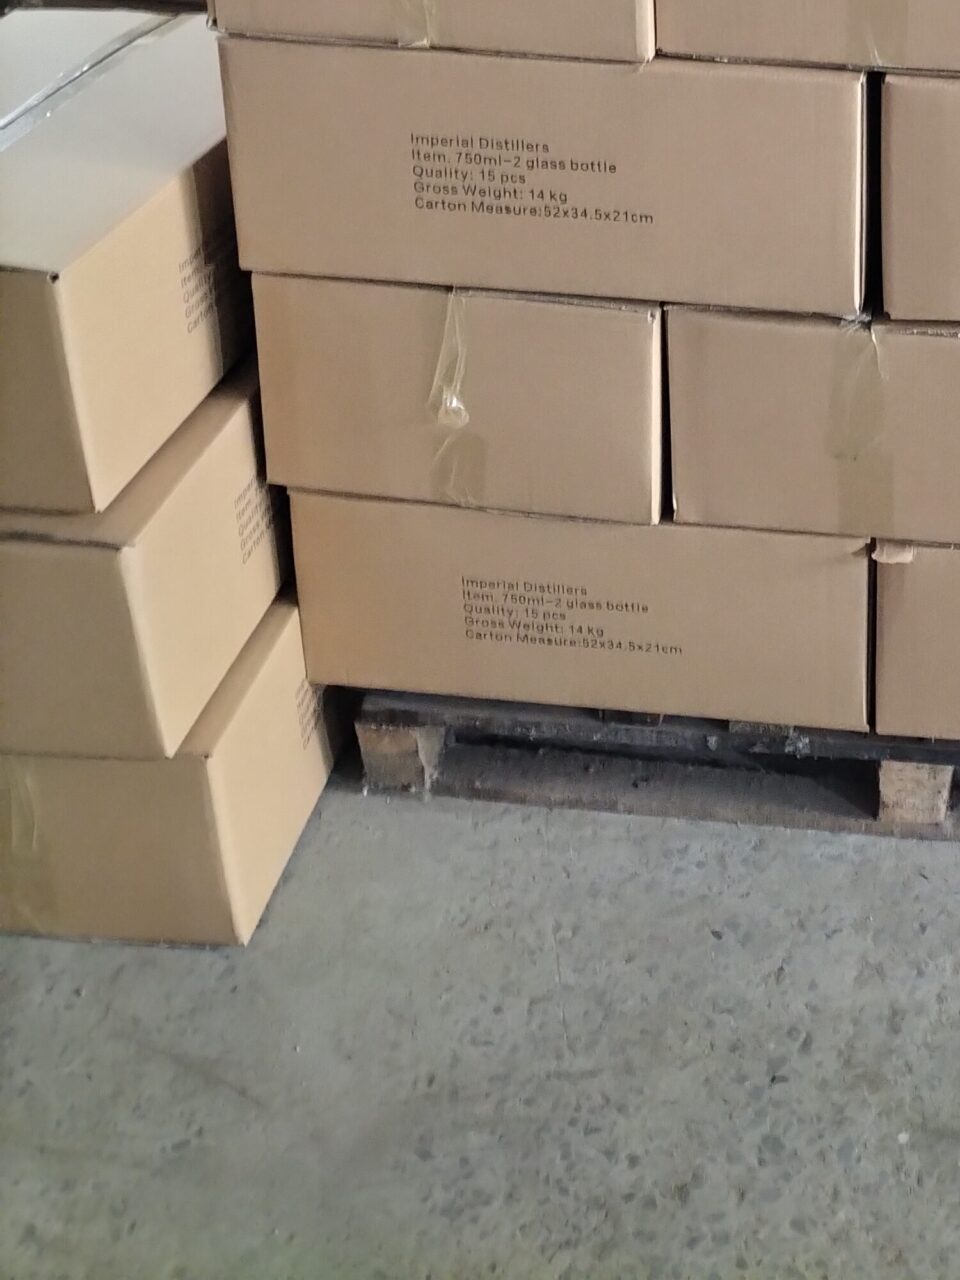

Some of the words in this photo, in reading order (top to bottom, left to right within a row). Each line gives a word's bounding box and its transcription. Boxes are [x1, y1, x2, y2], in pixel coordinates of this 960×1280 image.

[411, 132, 473, 149] Imperial
[480, 138, 549, 153] Distillers
[527, 158, 565, 170] glass
[570, 160, 617, 173] bottle
[413, 166, 473, 182] Quality:
[480, 170, 495, 181] 15
[501, 173, 525, 184] pcs
[414, 182, 457, 195] Gross
[463, 186, 523, 200] Weight:
[529, 190, 544, 201] 14
[550, 190, 567, 204] kg
[415, 197, 466, 211] Carton
